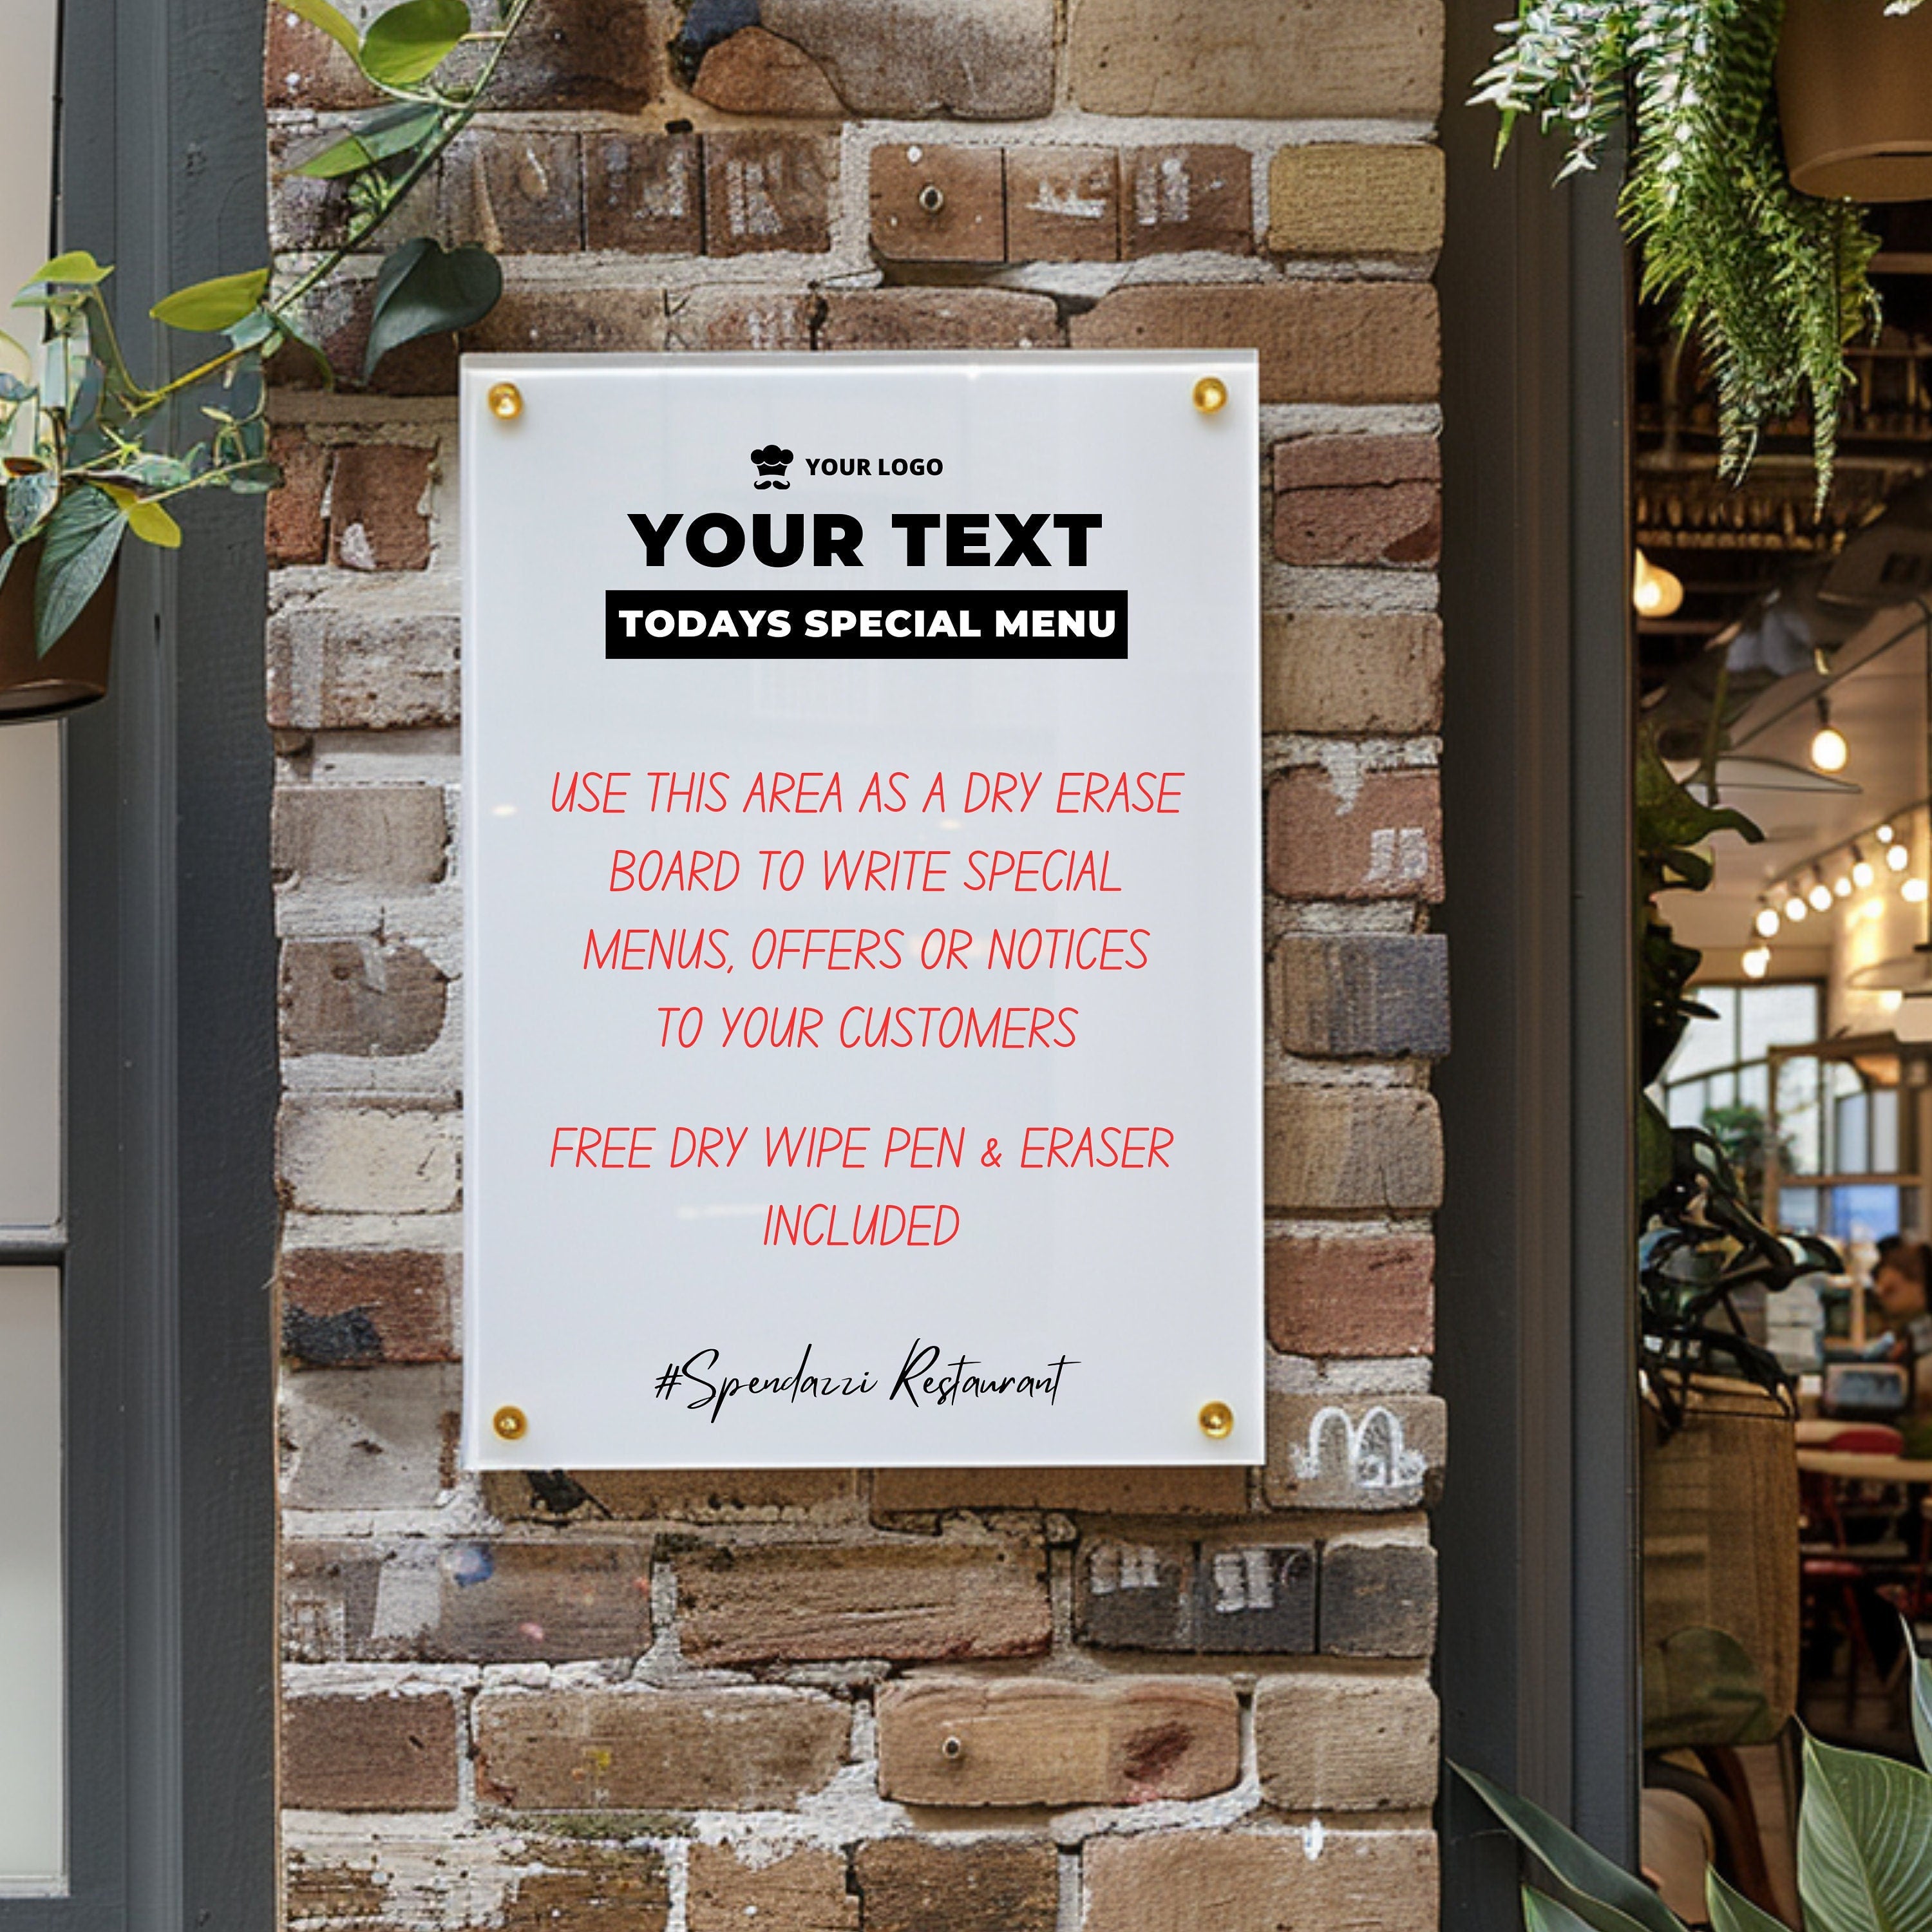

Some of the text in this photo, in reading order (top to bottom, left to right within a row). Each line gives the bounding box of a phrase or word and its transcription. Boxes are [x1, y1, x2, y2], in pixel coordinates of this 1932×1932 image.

[806, 459, 943, 475] YOUR LOGO
[627, 513, 1102, 567] YOUR TEXT
[619, 610, 1115, 637] TODAYS SPECIAL MENU
[551, 772, 1185, 813] USE THIS AREA AS A DRY ERASE
[610, 849, 1122, 891] BOARD TO WRITE SPECIAL
[583, 927, 1150, 974] MENUS, OFFERS OR NOTICES
[658, 1006, 1079, 1048] TO YOUR CUSTOMERS
[550, 1126, 1174, 1168] FREE DRY WIPE PEN & ERASER
[764, 1204, 960, 1246] INCLUDED
[655, 1338, 1081, 1423] #Spendazzi Restaurant
